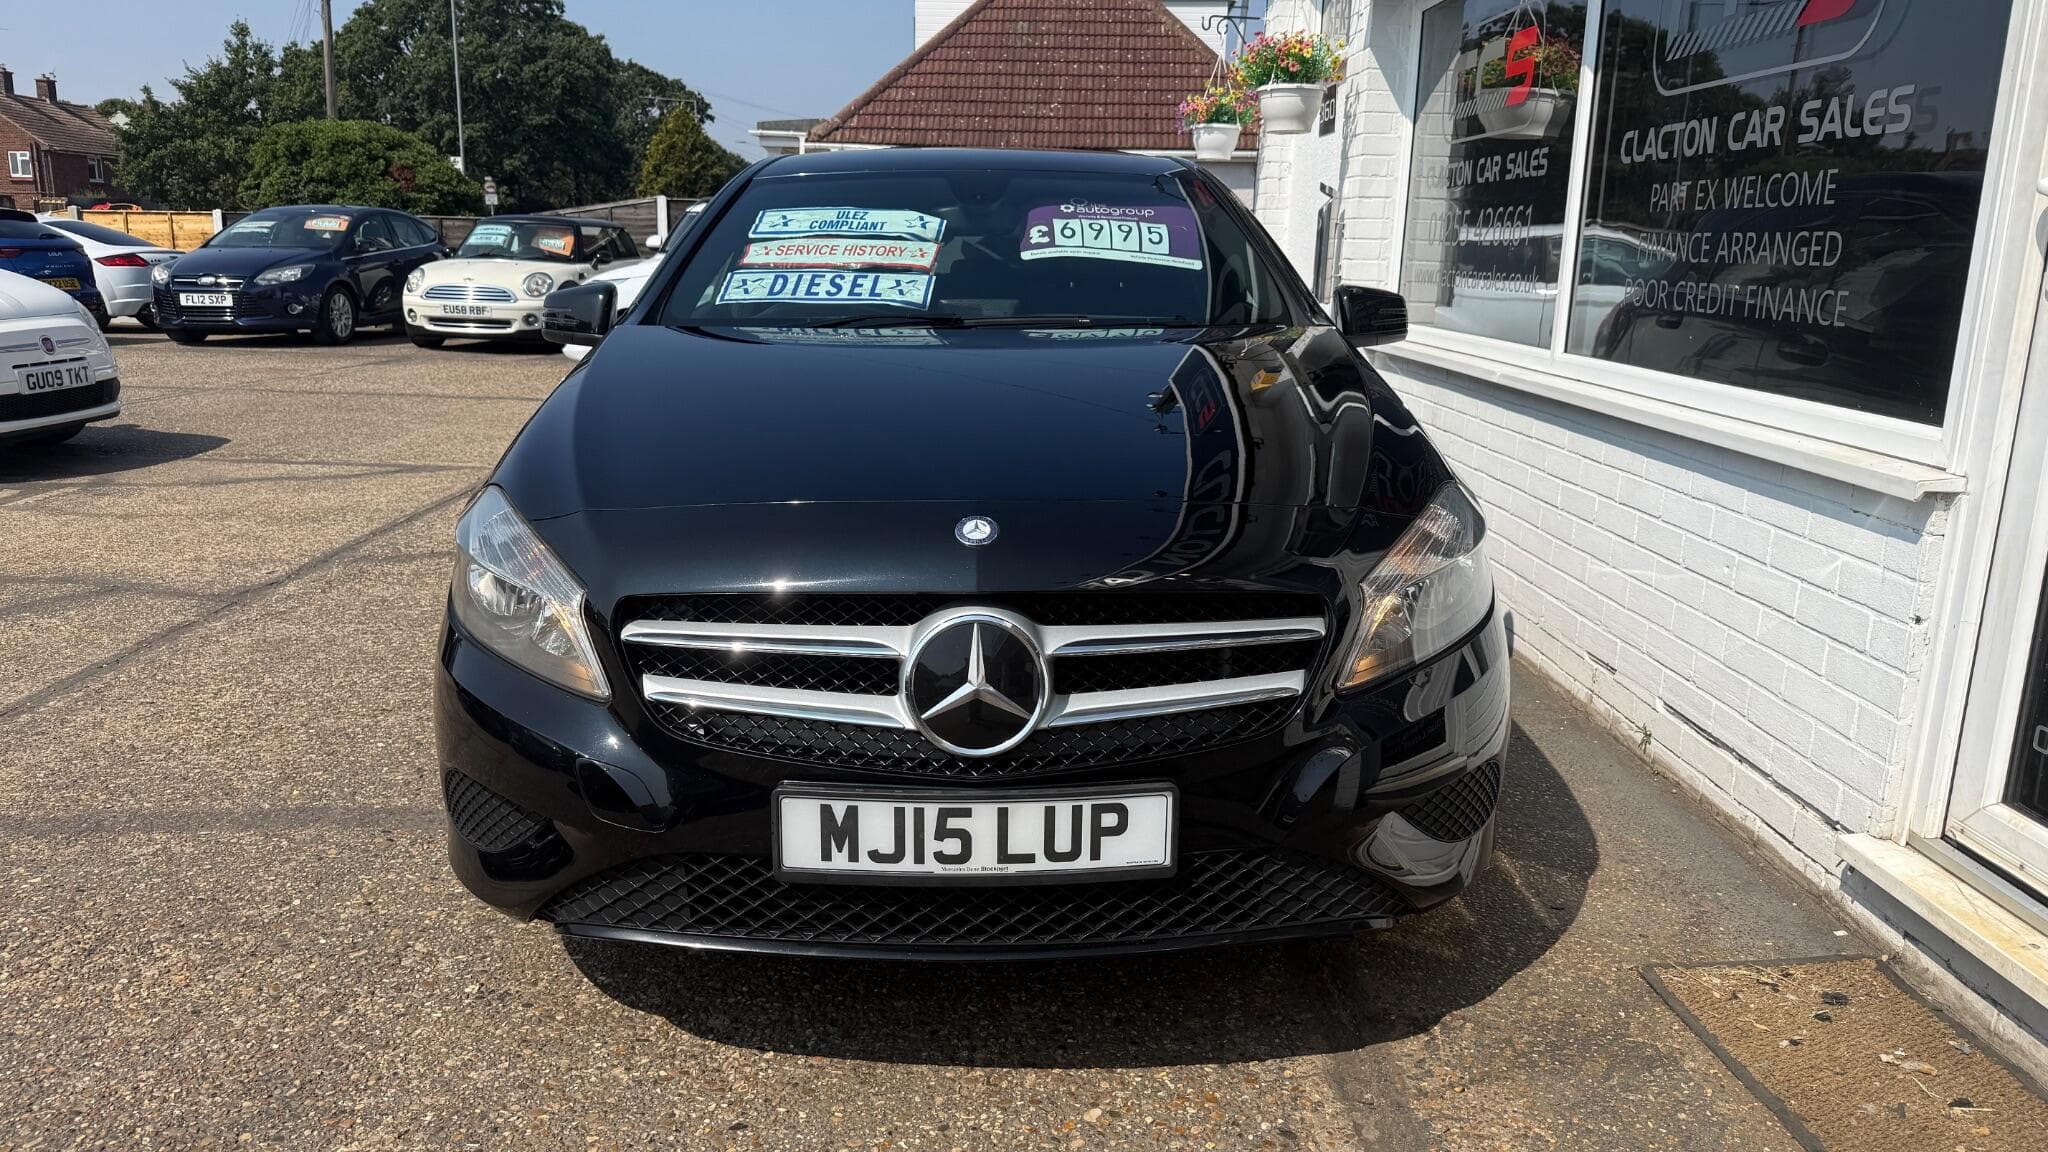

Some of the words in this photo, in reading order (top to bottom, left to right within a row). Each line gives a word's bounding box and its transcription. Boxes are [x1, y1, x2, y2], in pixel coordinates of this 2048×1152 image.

[1620, 116, 1717, 164] CLACTON
[1727, 105, 1785, 150] CAR
[1798, 84, 1916, 144] SALES
[1477, 155, 1501, 183] CAR
[1505, 147, 1549, 180] SALES
[1650, 180, 1692, 213] PART
[1695, 178, 1719, 211] EX
[1724, 168, 1840, 209] WELCOME
[836, 211, 869, 220] ULEZ
[1076, 204, 1155, 218] autogroup
[809, 220, 887, 231] COMPLIANT
[1429, 210, 1471, 246] 01255
[1473, 203, 1533, 247] 426661
[775, 244, 840, 256] SERVICE
[842, 245, 907, 257] HISTORY
[1637, 232, 1712, 264] FINANCE
[1714, 230, 1842, 267] ARRANGED
[766, 274, 883, 297] DIESEL
[185, 295, 206, 305] FL12
[208, 295, 227, 305] SXP
[443, 304, 467, 314] EU58
[469, 305, 487, 315] RBF
[1624, 278, 1669, 309] POOR
[1673, 281, 1739, 317] CREDIT
[1744, 285, 1849, 327] FINANCE
[26, 369, 64, 391] GU09
[65, 366, 89, 385] TKT
[819, 803, 973, 865] MJ15
[997, 802, 1129, 864] LUP
